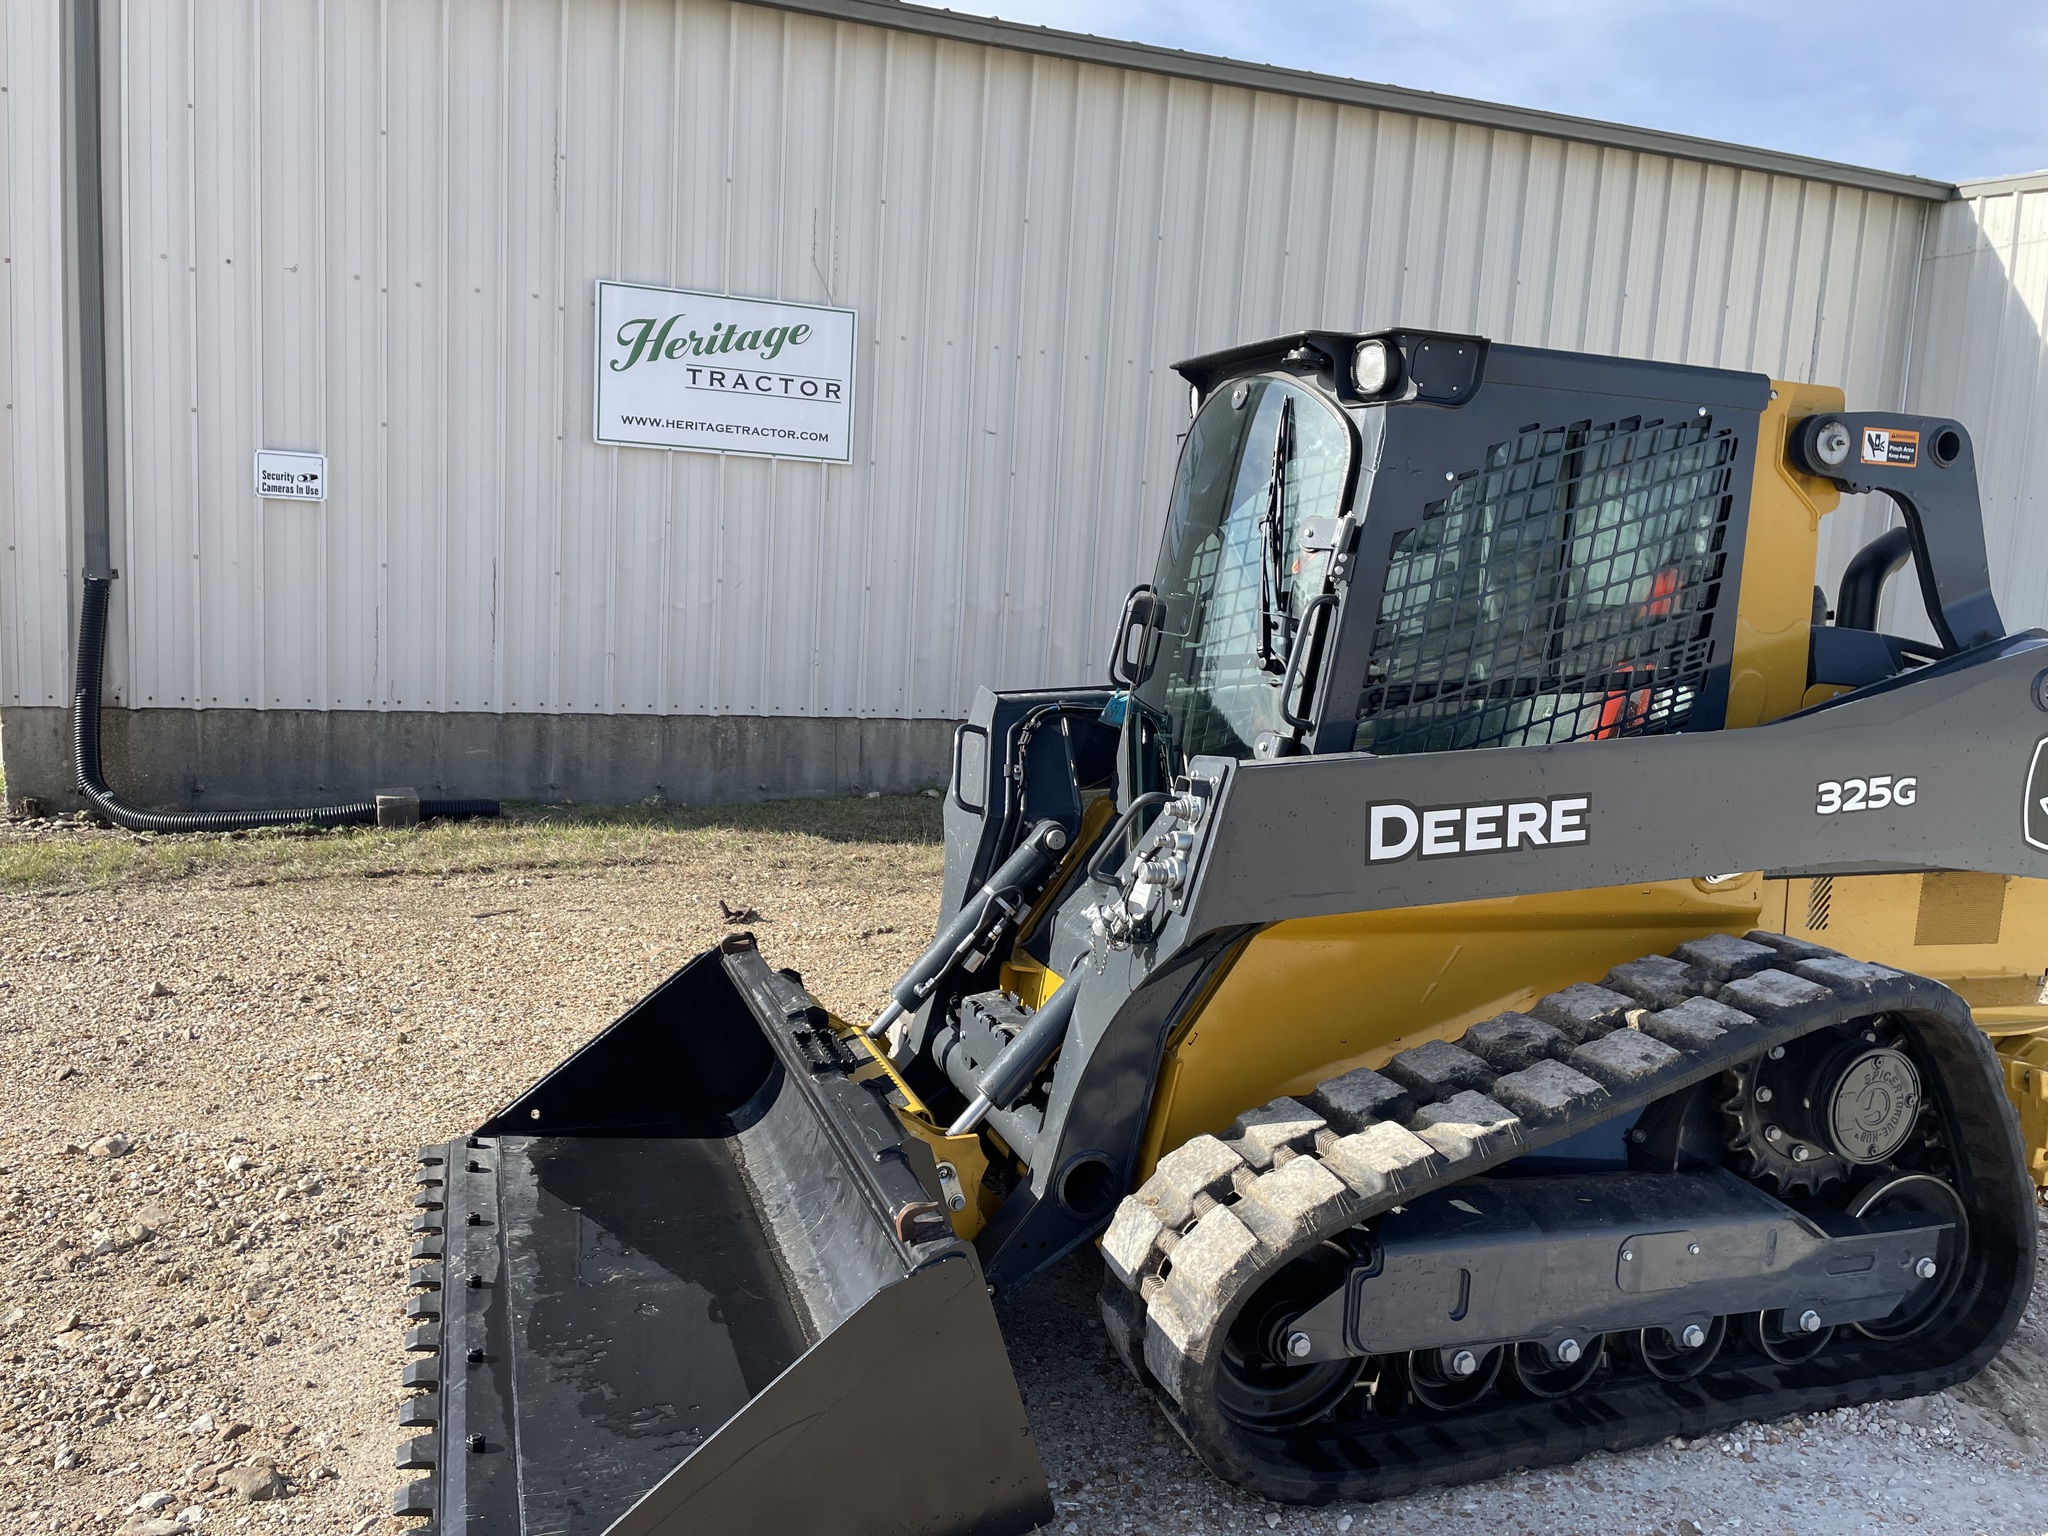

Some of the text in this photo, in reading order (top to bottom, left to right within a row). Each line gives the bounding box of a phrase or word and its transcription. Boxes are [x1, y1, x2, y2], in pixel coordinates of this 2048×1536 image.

[609, 313, 814, 372] Heritage
[686, 367, 841, 400] TRACTOR
[620, 414, 829, 442] WWW.HERITAGETRACTOR.COM
[1888, 452, 1911, 461] Keep Away
[1889, 444, 1915, 453] Pinch Area
[261, 469, 295, 484] Security
[261, 481, 319, 496] Cameras In Use
[1816, 775, 1917, 815] 325G
[1370, 797, 1588, 860] DEERE
[1864, 1069, 1903, 1094] SPICER
